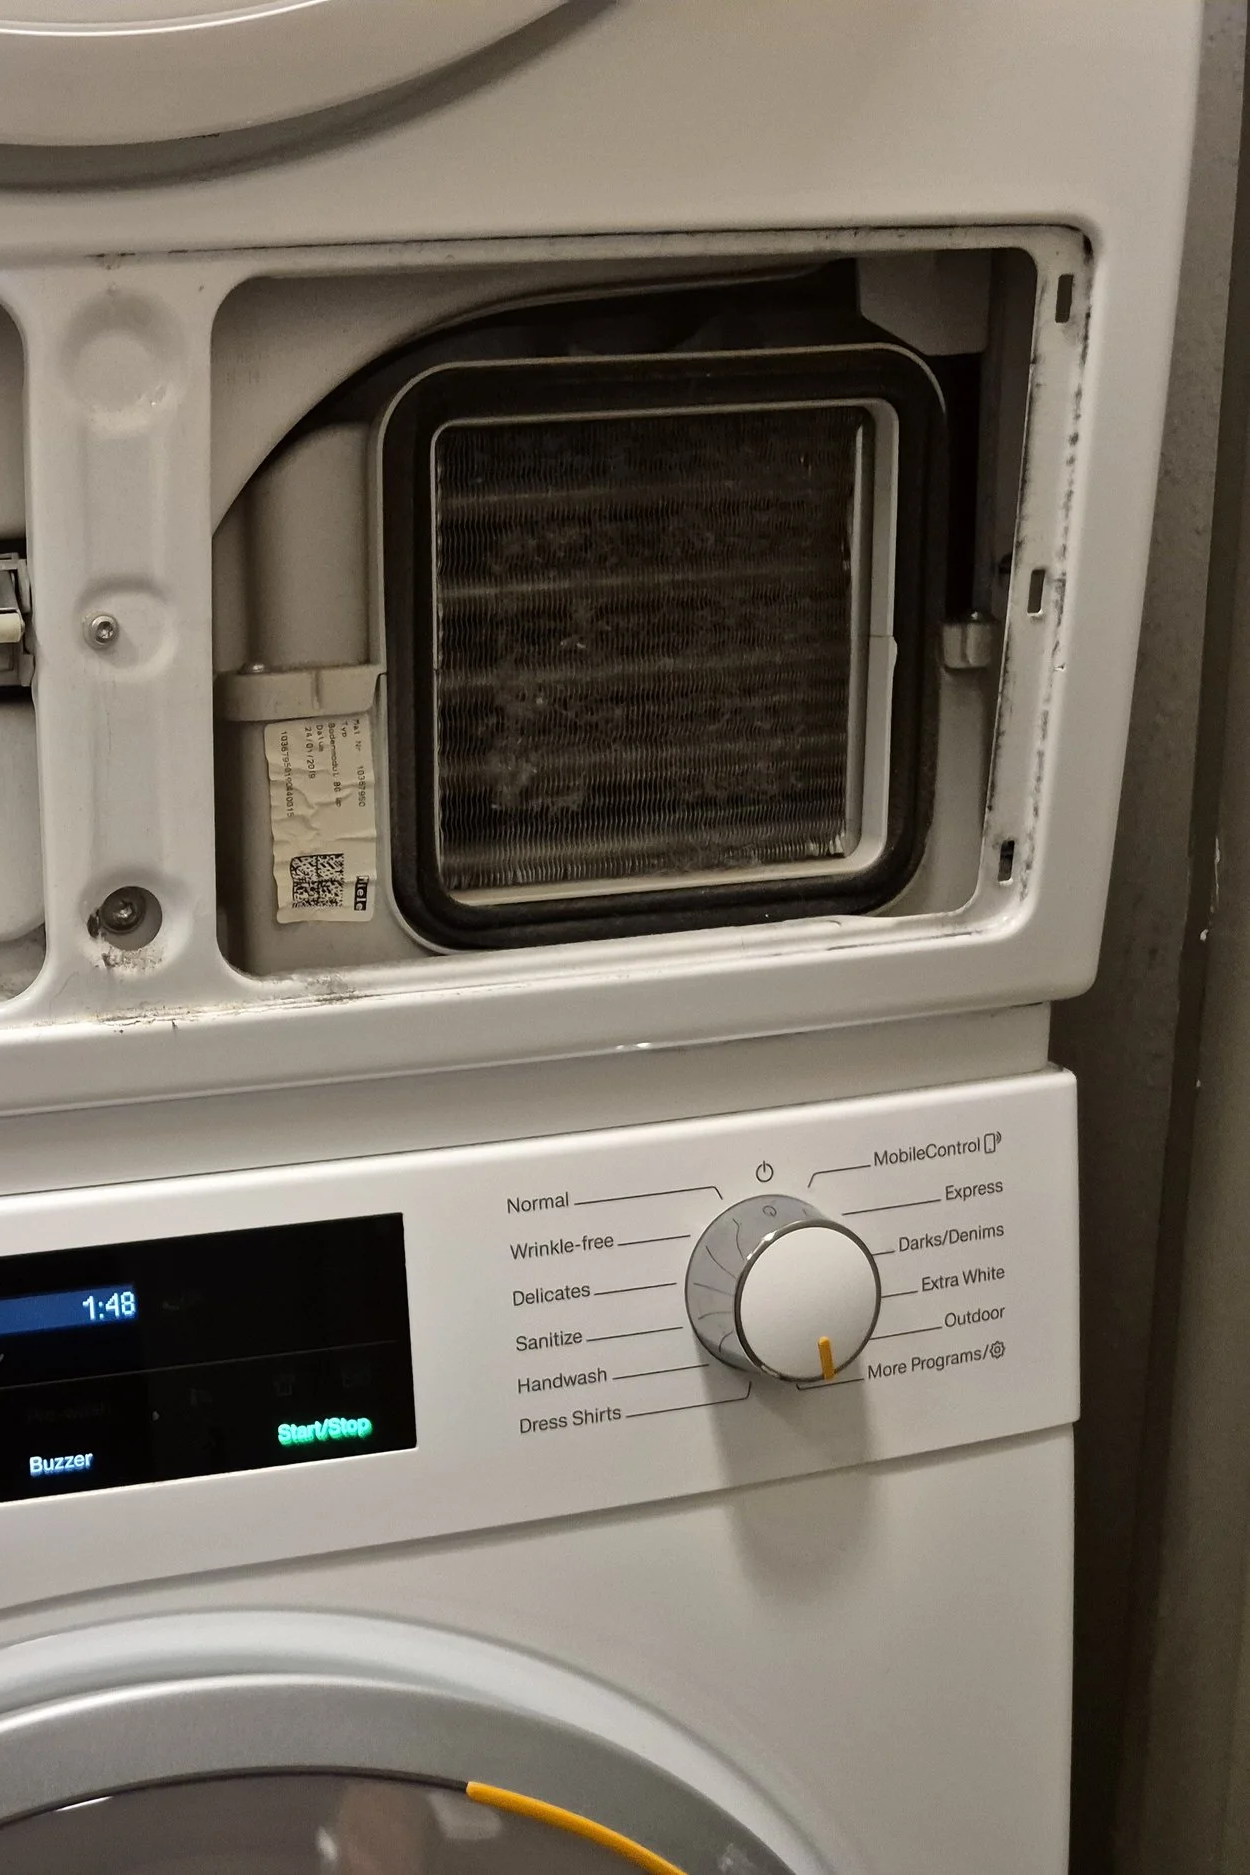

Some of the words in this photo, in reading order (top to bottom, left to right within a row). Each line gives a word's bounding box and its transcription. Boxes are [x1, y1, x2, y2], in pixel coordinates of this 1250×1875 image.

[873, 1137, 981, 1168] MobileControl
[506, 1192, 570, 1214] Normal
[944, 1178, 1004, 1203] Express
[510, 1232, 615, 1260] Wrinkle-free
[898, 1222, 1005, 1253] Darks/Denims
[921, 1271, 960, 1293] Extra
[962, 1265, 1006, 1287] White
[82, 1289, 137, 1321] 1:48
[512, 1281, 591, 1306] Delicates
[943, 1304, 1006, 1328] Outdoor
[515, 1328, 583, 1352] Sanitize
[517, 1366, 608, 1395] Handwash
[867, 1359, 907, 1381] More
[277, 1414, 373, 1446] Start/Stop
[519, 1412, 568, 1434] Dress
[571, 1405, 622, 1427] Shirts
[29, 1449, 94, 1476] Buzzer
